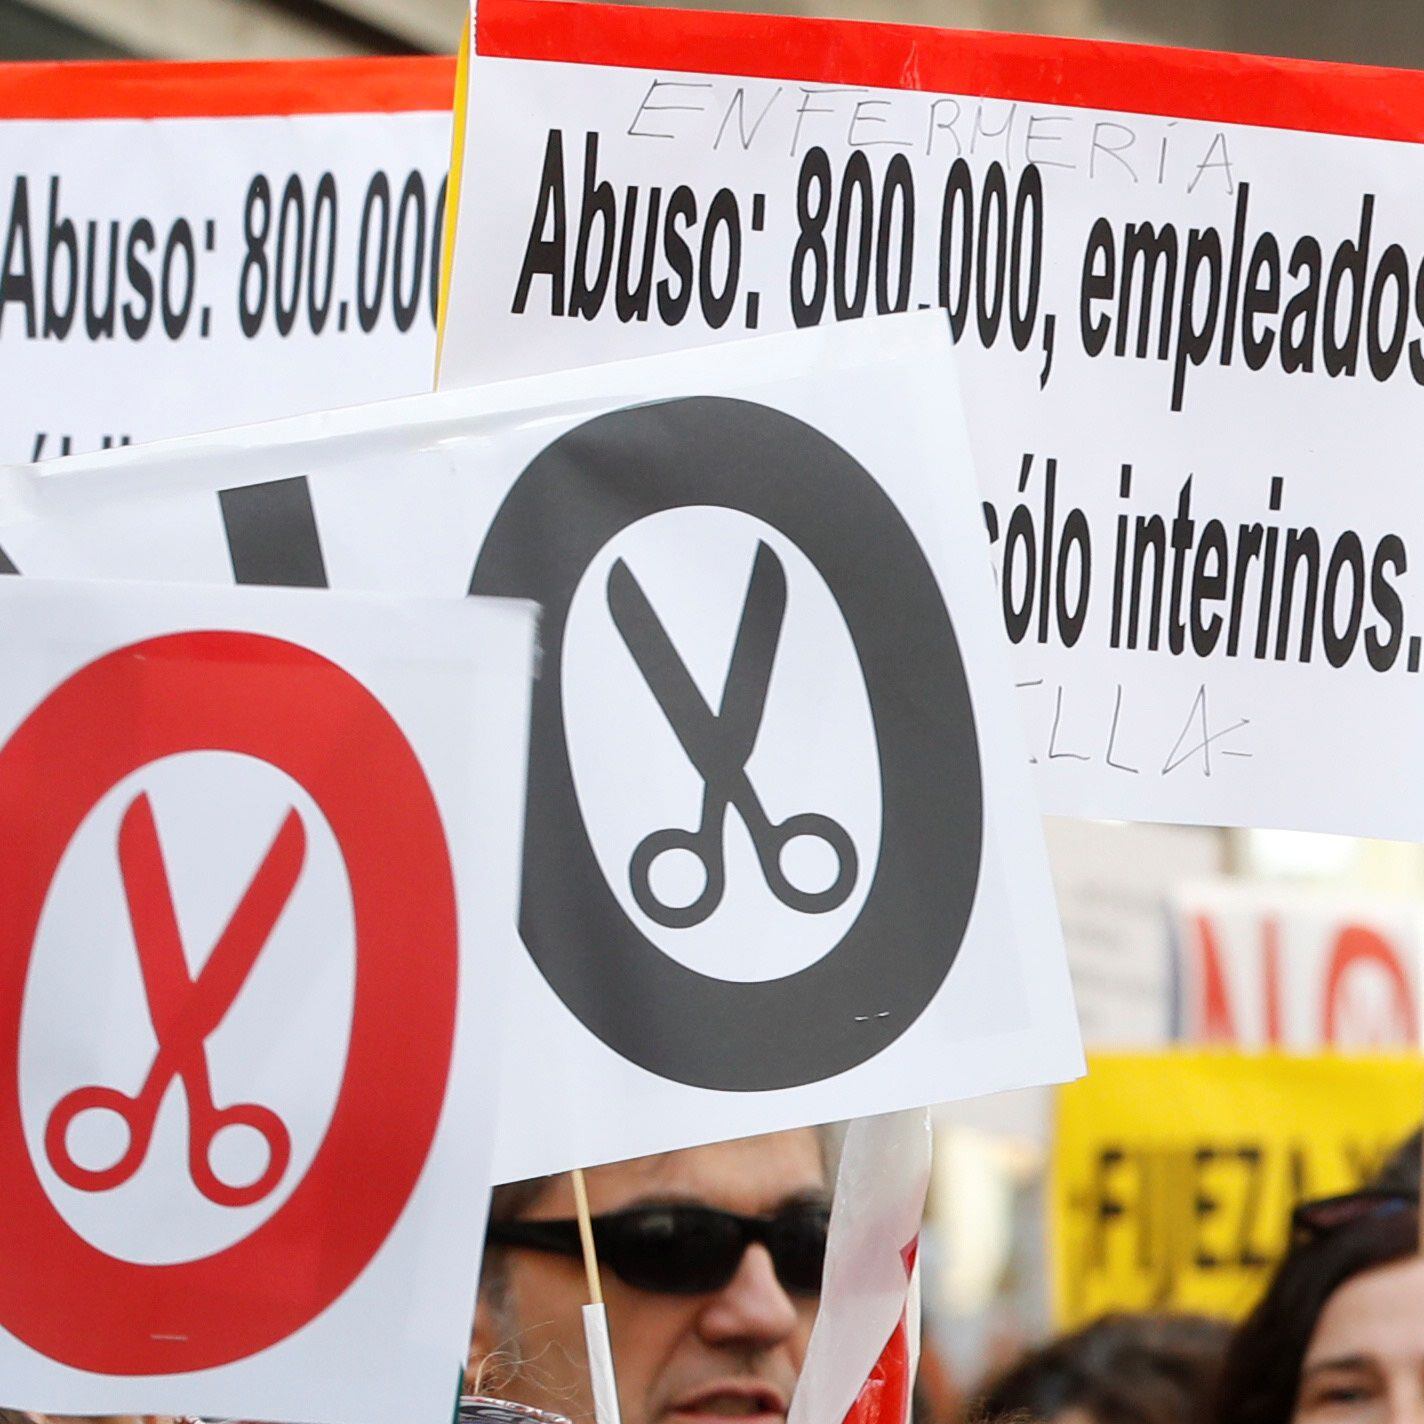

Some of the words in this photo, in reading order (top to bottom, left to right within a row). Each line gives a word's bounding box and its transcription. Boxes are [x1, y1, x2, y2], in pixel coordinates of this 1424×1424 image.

[0, 174, 212, 342] Abuso:
[512, 128, 765, 330] Abuso:
[789, 146, 1057, 391] 800.000,
[1109, 463, 1422, 673] interinos.
